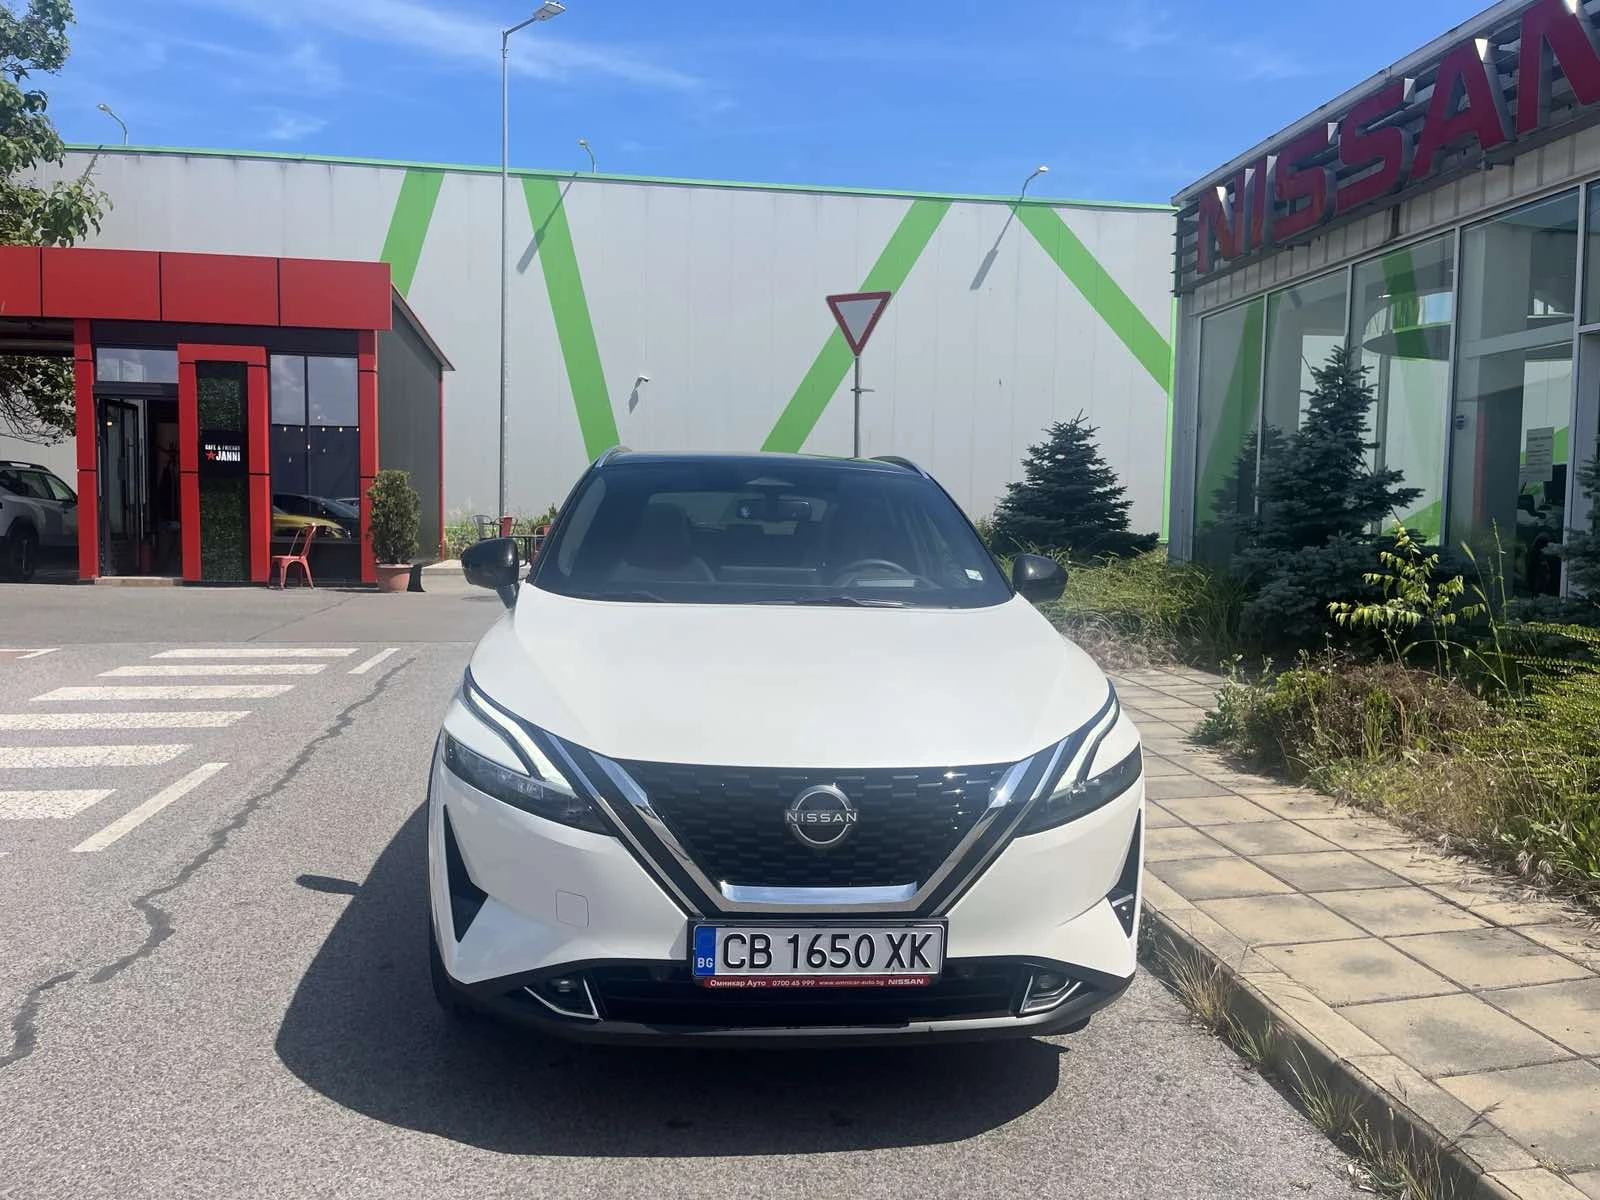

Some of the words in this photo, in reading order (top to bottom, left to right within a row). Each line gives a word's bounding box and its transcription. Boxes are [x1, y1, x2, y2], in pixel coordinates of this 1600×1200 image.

[1197, 0, 1600, 274] NISSAN
[216, 451, 240, 461] JANNI
[786, 812, 857, 823] NISSAN
[787, 934, 875, 968] 1650
[697, 958, 713, 967] BG
